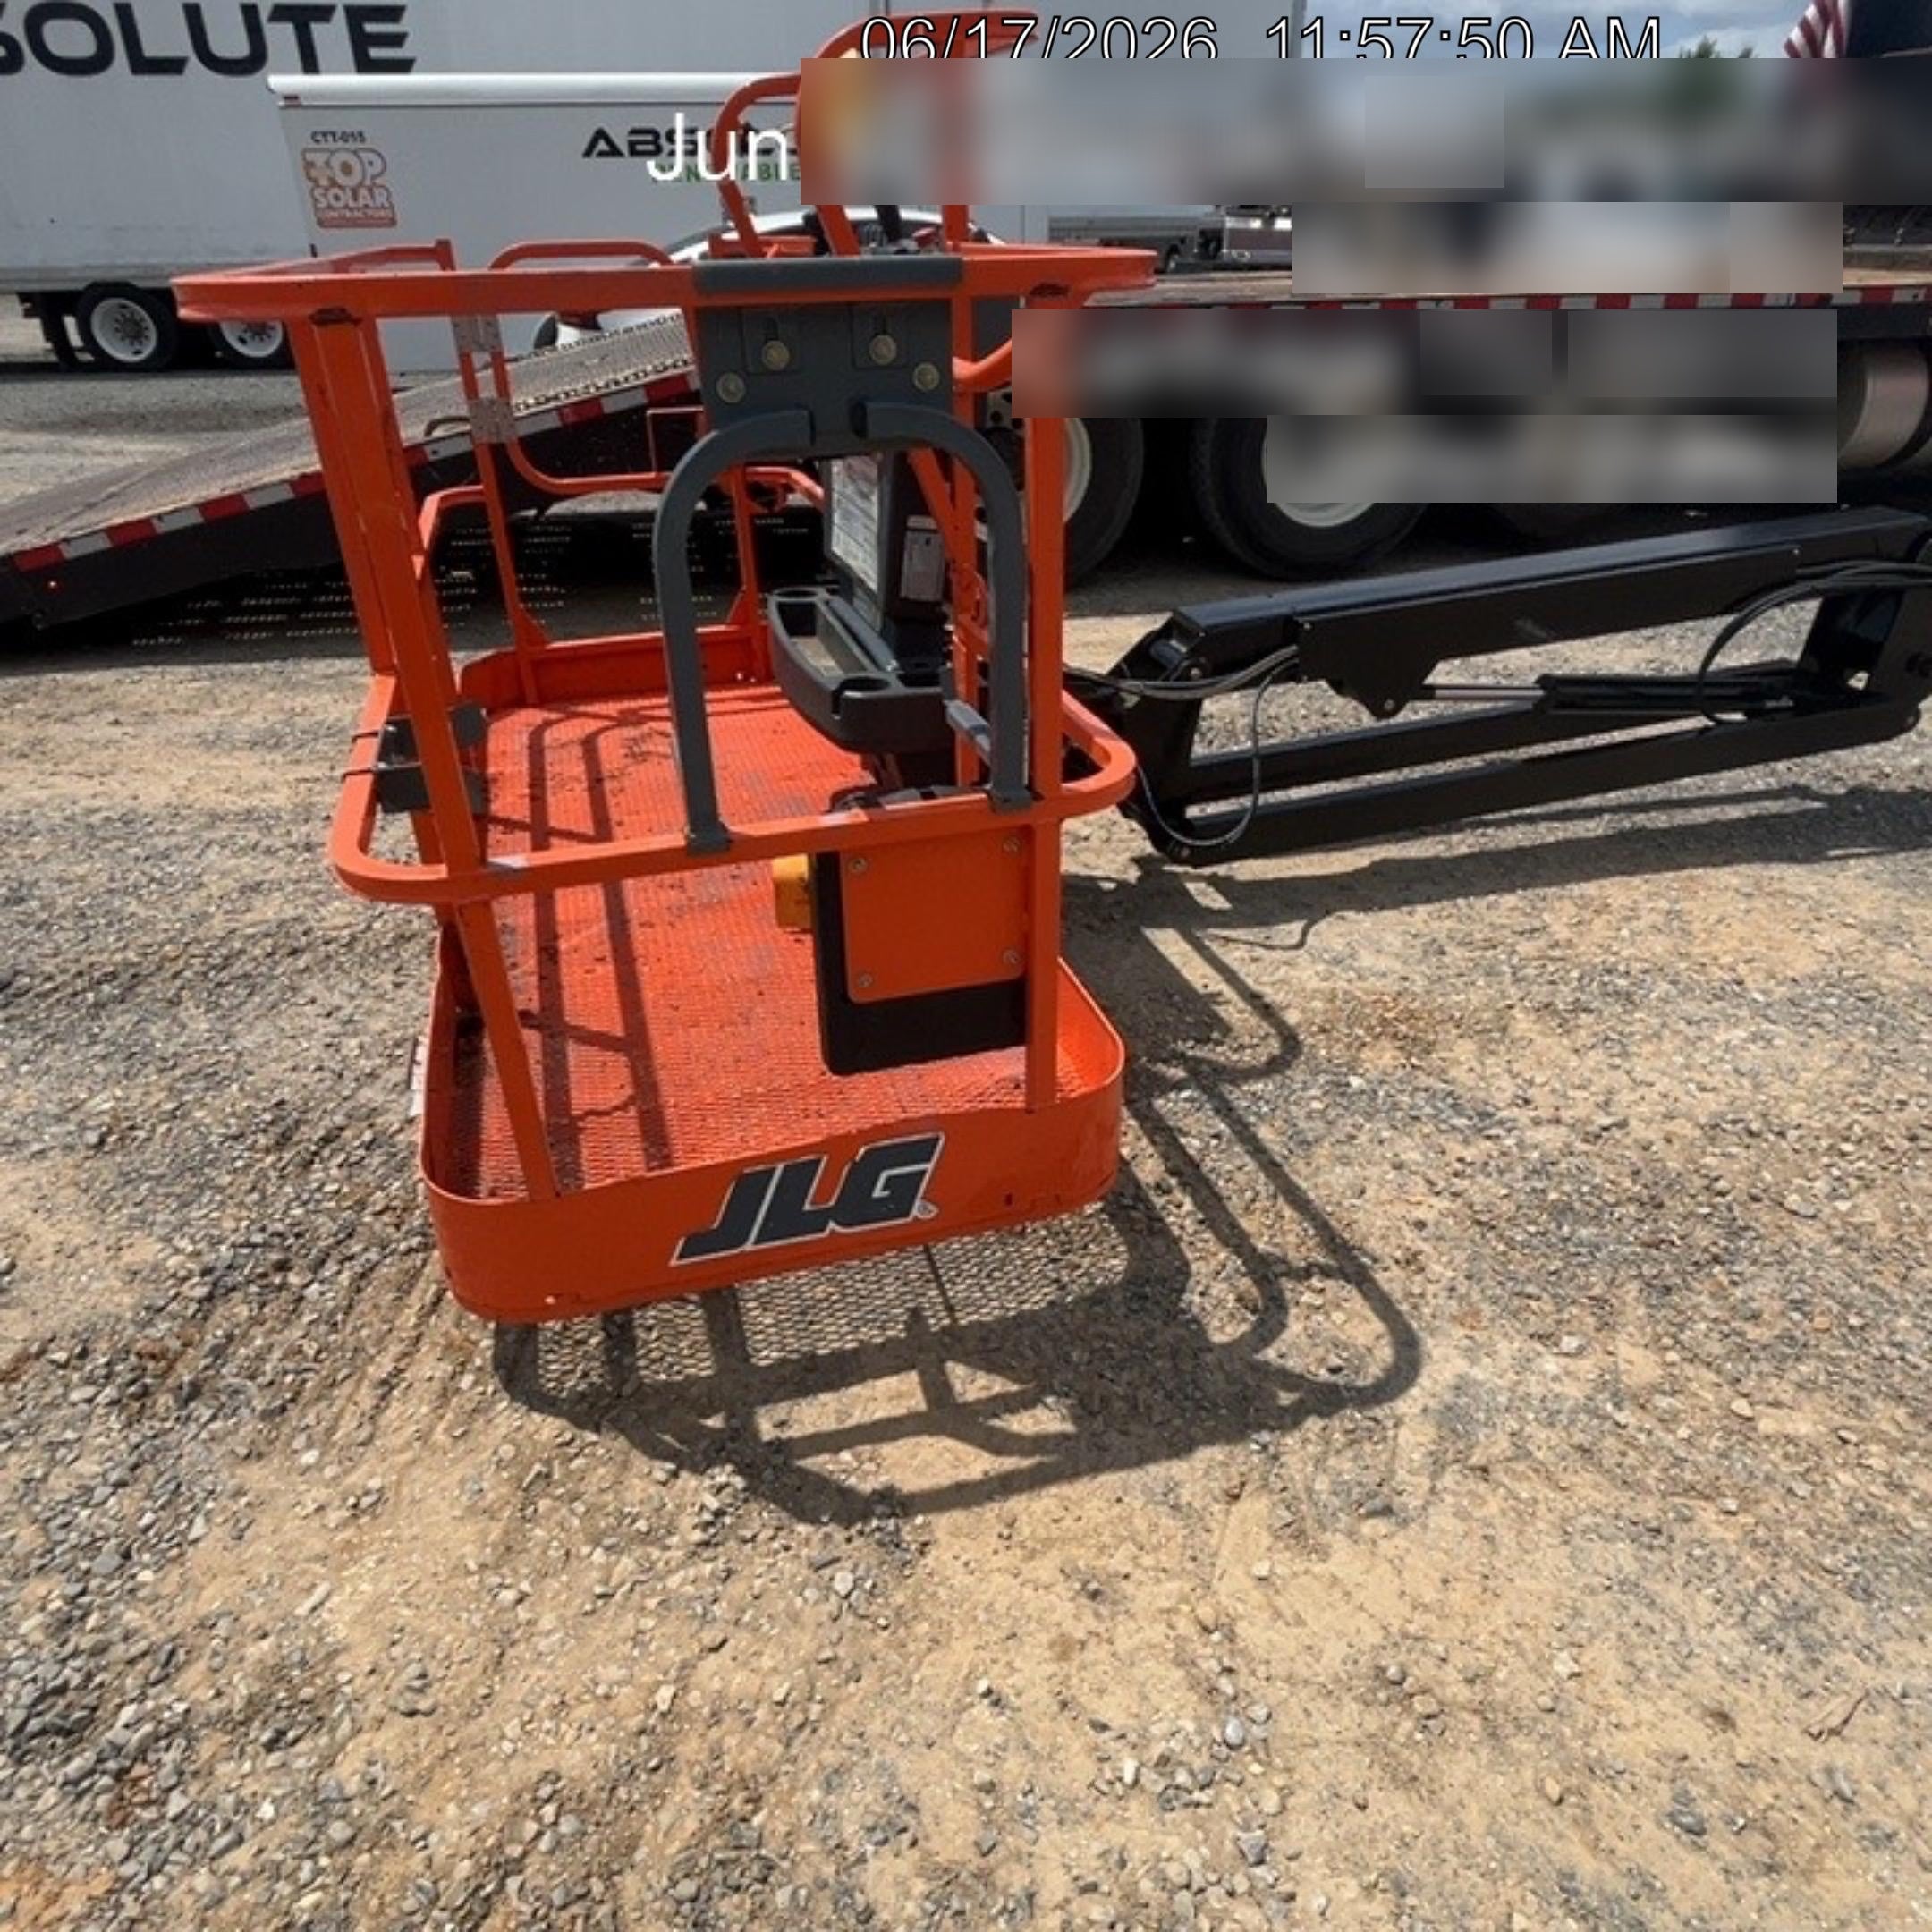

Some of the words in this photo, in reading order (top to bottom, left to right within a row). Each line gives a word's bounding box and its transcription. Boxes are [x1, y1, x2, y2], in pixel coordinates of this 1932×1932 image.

[301, 147, 386, 187] TOP
[312, 185, 392, 208] SOLAR
[669, 1131, 944, 1267] JLG
